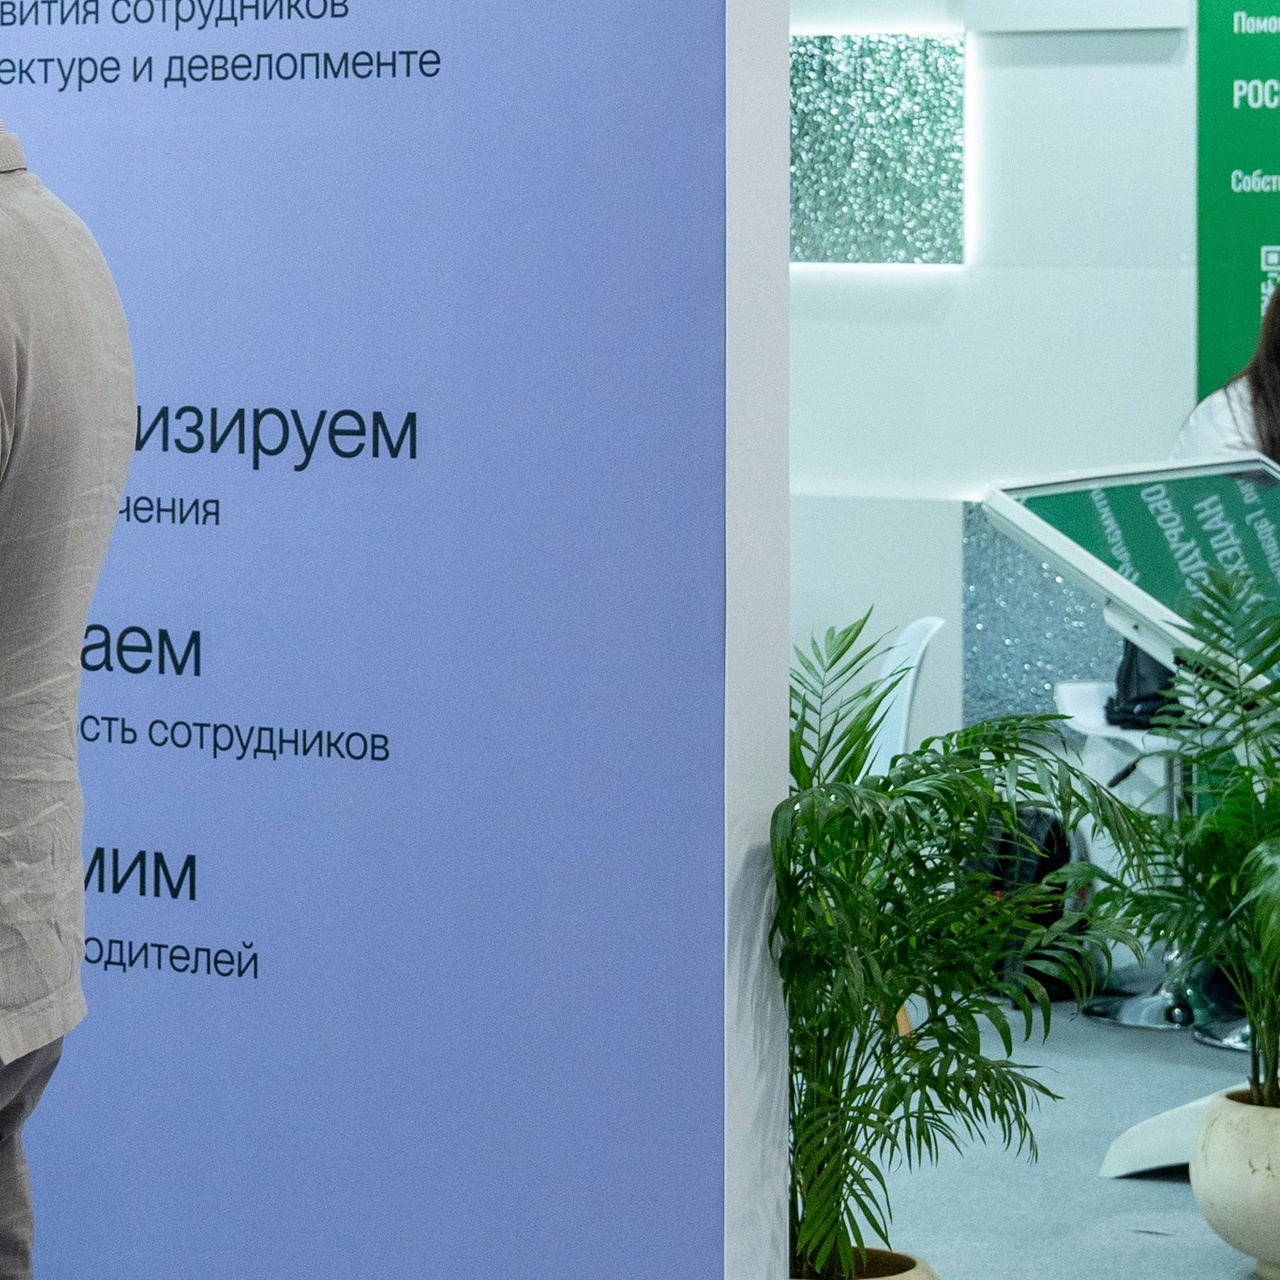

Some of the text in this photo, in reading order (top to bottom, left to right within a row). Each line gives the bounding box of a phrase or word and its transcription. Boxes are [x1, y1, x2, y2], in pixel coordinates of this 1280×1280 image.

[1233, 11, 1280, 34] Помо
[133, 56, 153, 83] и
[163, 46, 442, 89] девелопменте
[1231, 168, 1280, 193] Собст
[135, 405, 418, 472] изируем
[80, 624, 202, 677] аем
[148, 719, 391, 761] сотрудников
[84, 936, 260, 980] одителей
